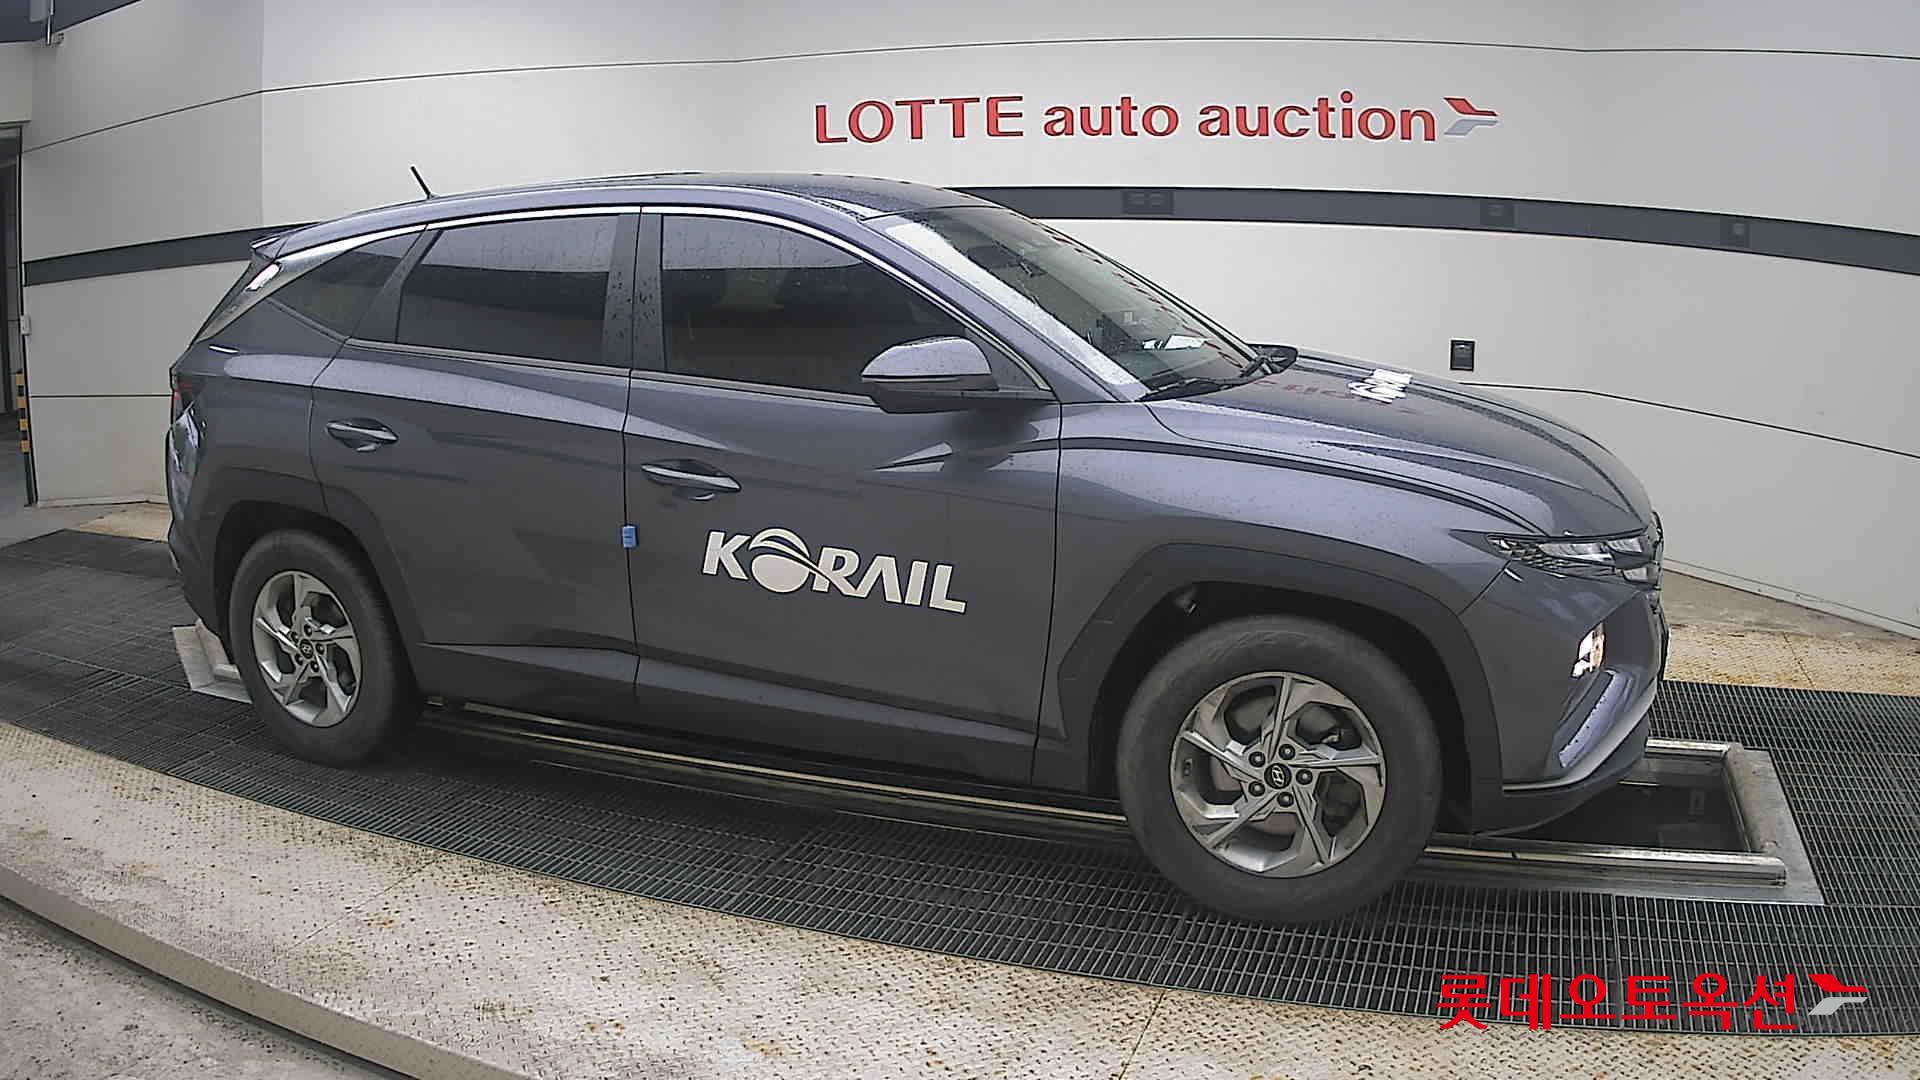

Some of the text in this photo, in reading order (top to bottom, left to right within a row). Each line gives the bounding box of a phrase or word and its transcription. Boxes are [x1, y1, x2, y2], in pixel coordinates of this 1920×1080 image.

[815, 90, 1437, 143] LOTTE auto auction
[702, 528, 967, 613] KORAIL
